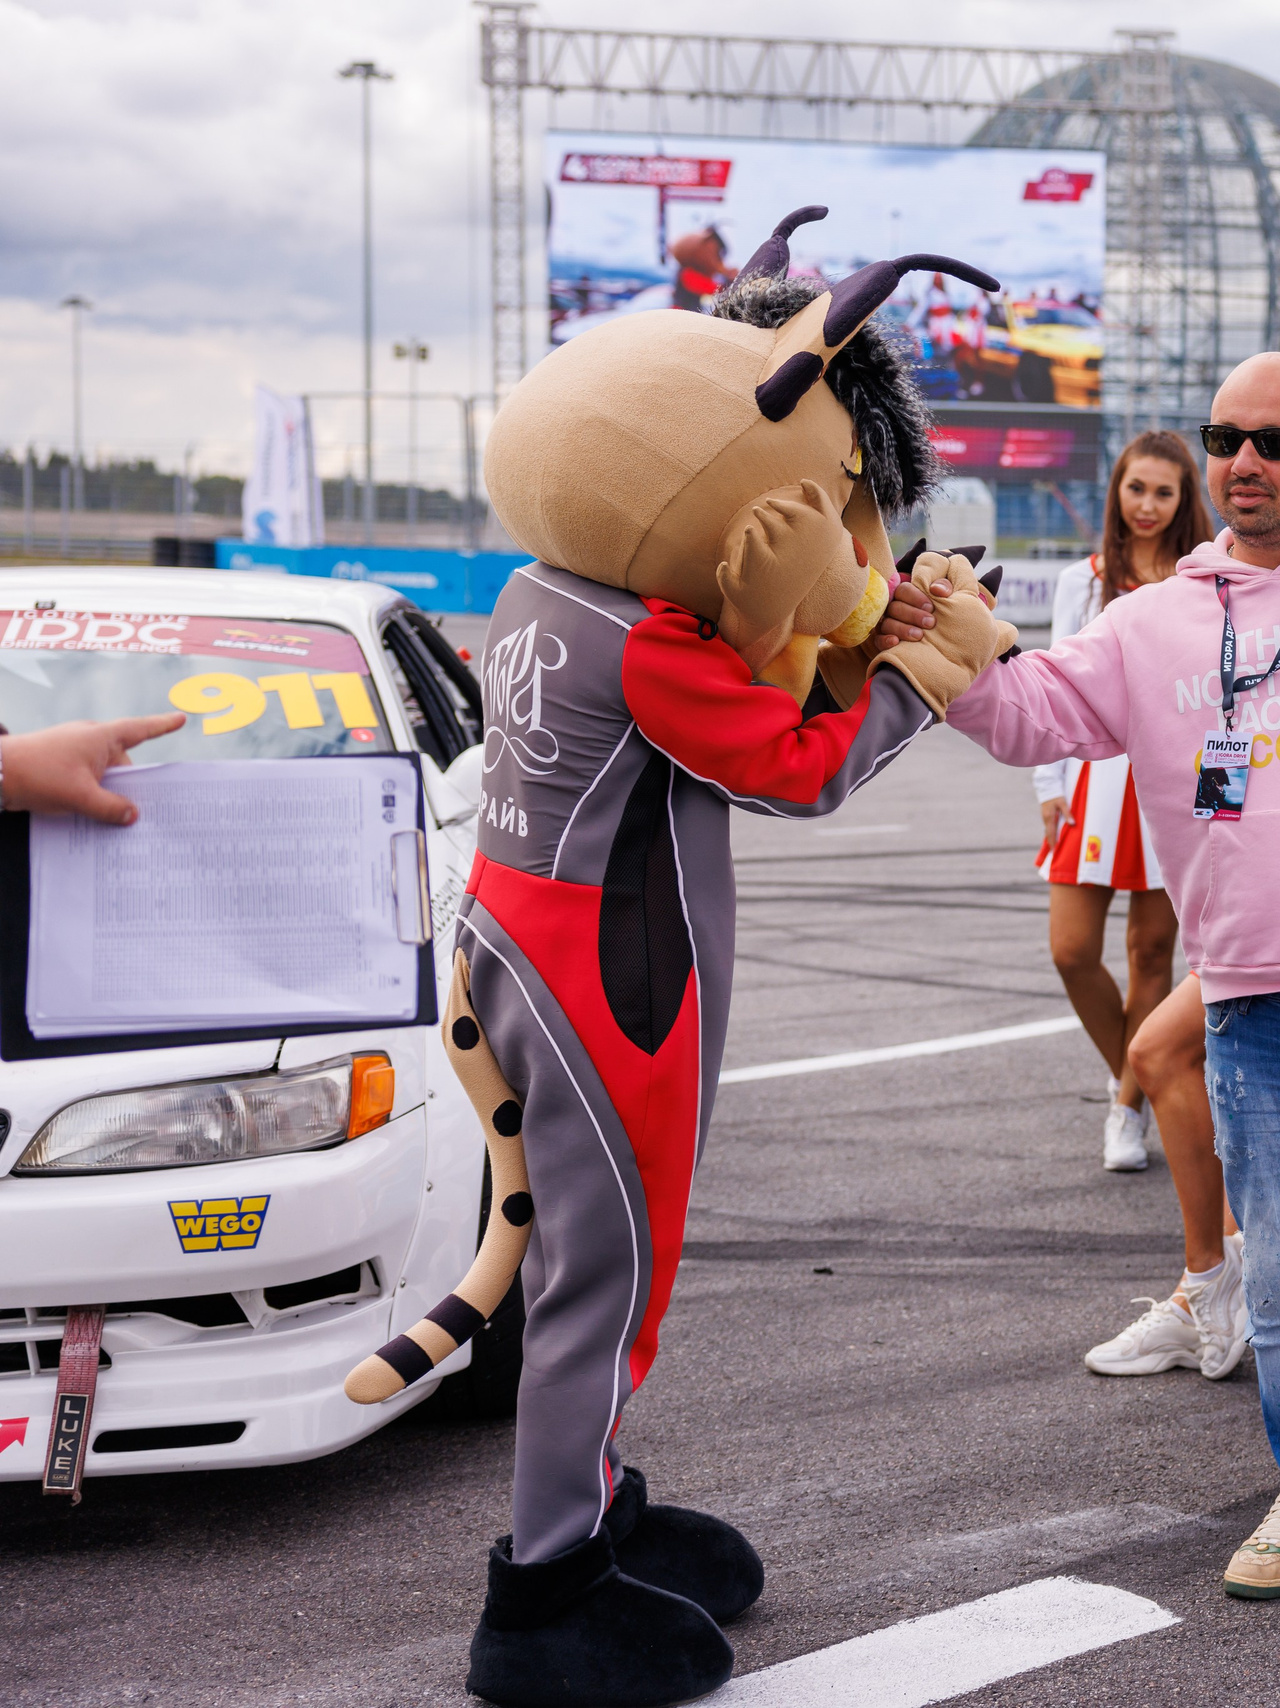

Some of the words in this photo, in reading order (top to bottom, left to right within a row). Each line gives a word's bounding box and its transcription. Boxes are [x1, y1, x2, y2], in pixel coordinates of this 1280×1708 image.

[2, 617, 187, 646] IDDC
[1, 640, 61, 650] DRIFT
[63, 641, 183, 654] CHALLENGE
[1223, 640, 1234, 672] ИГОРА
[168, 672, 379, 735] 911
[1207, 740, 1249, 752] ПИЛОТ
[479, 787, 529, 837] РАЙВ
[175, 1213, 261, 1236] WEGO
[54, 1399, 80, 1470] LUKE
